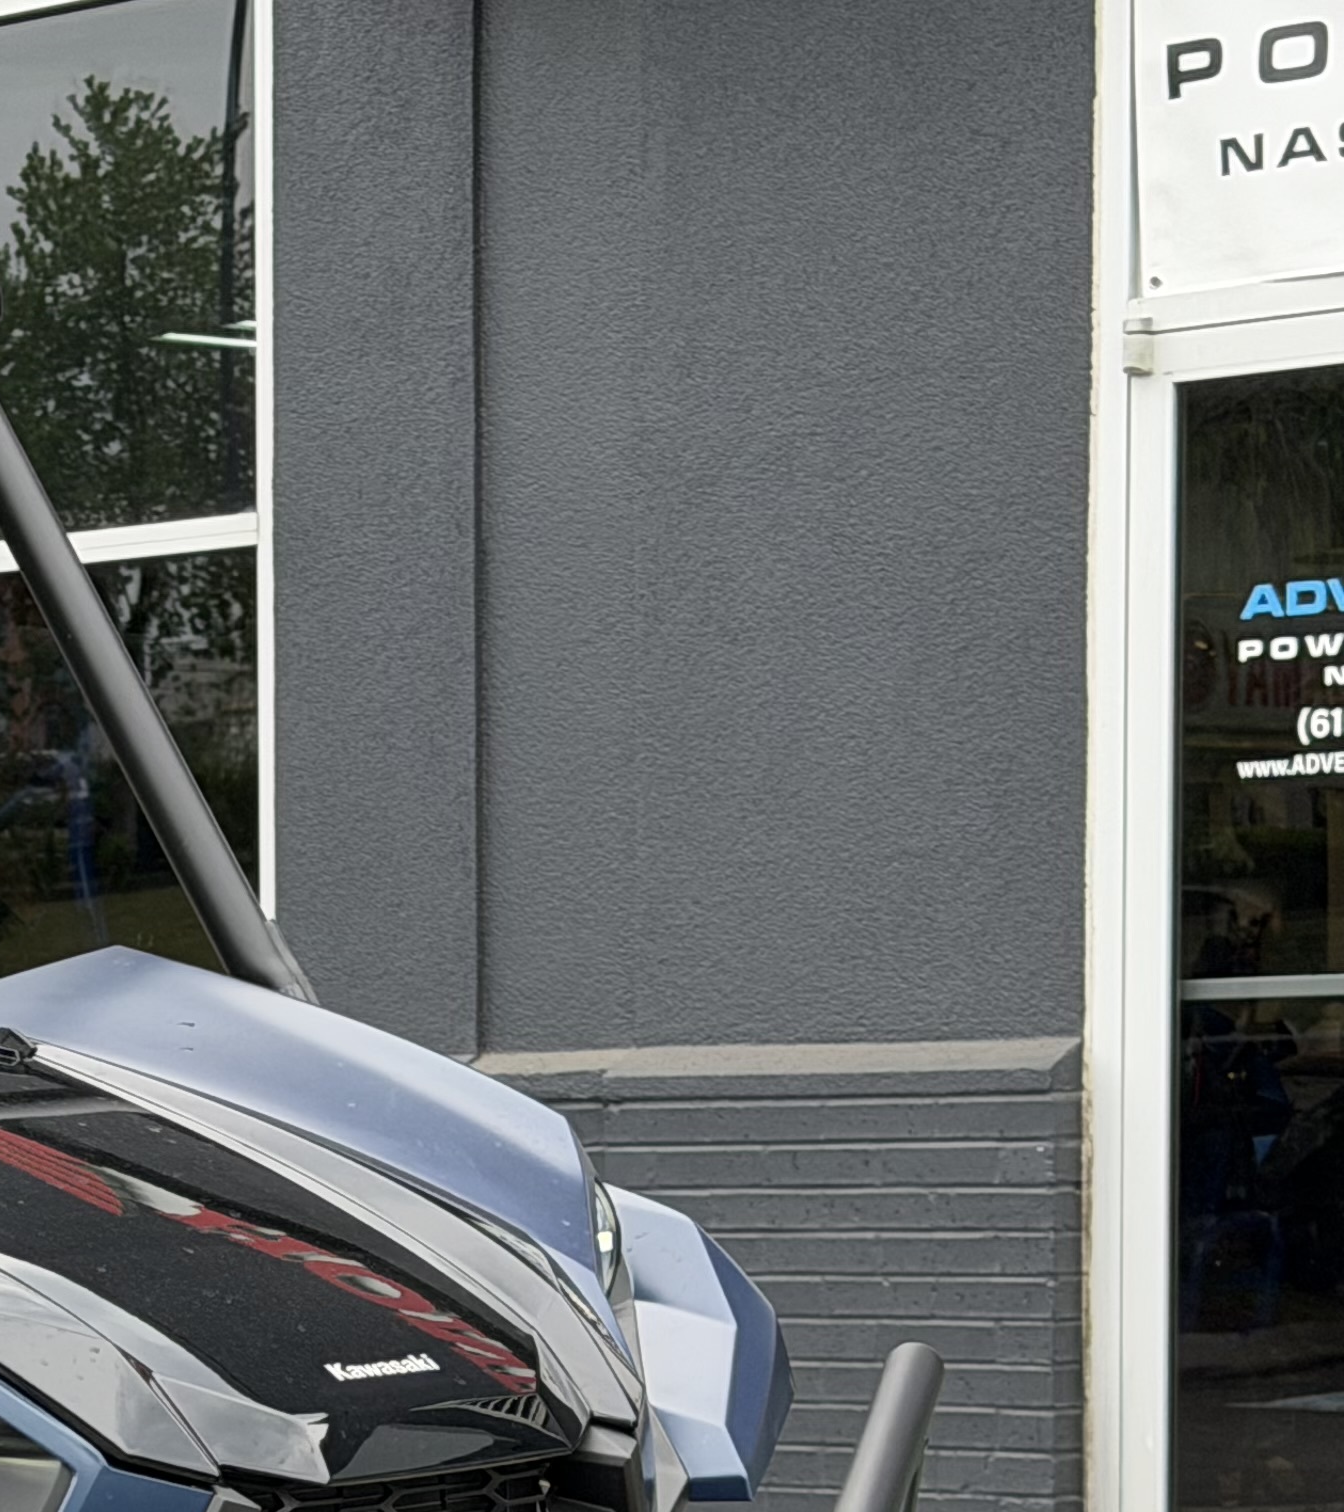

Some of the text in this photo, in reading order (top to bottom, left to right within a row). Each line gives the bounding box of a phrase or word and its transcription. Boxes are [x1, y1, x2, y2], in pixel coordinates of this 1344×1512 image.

[1219, 121, 1344, 176] NA
[1237, 632, 1344, 663] POW
[1296, 706, 1343, 746] (61
[324, 1353, 440, 1381] Kawasaki
